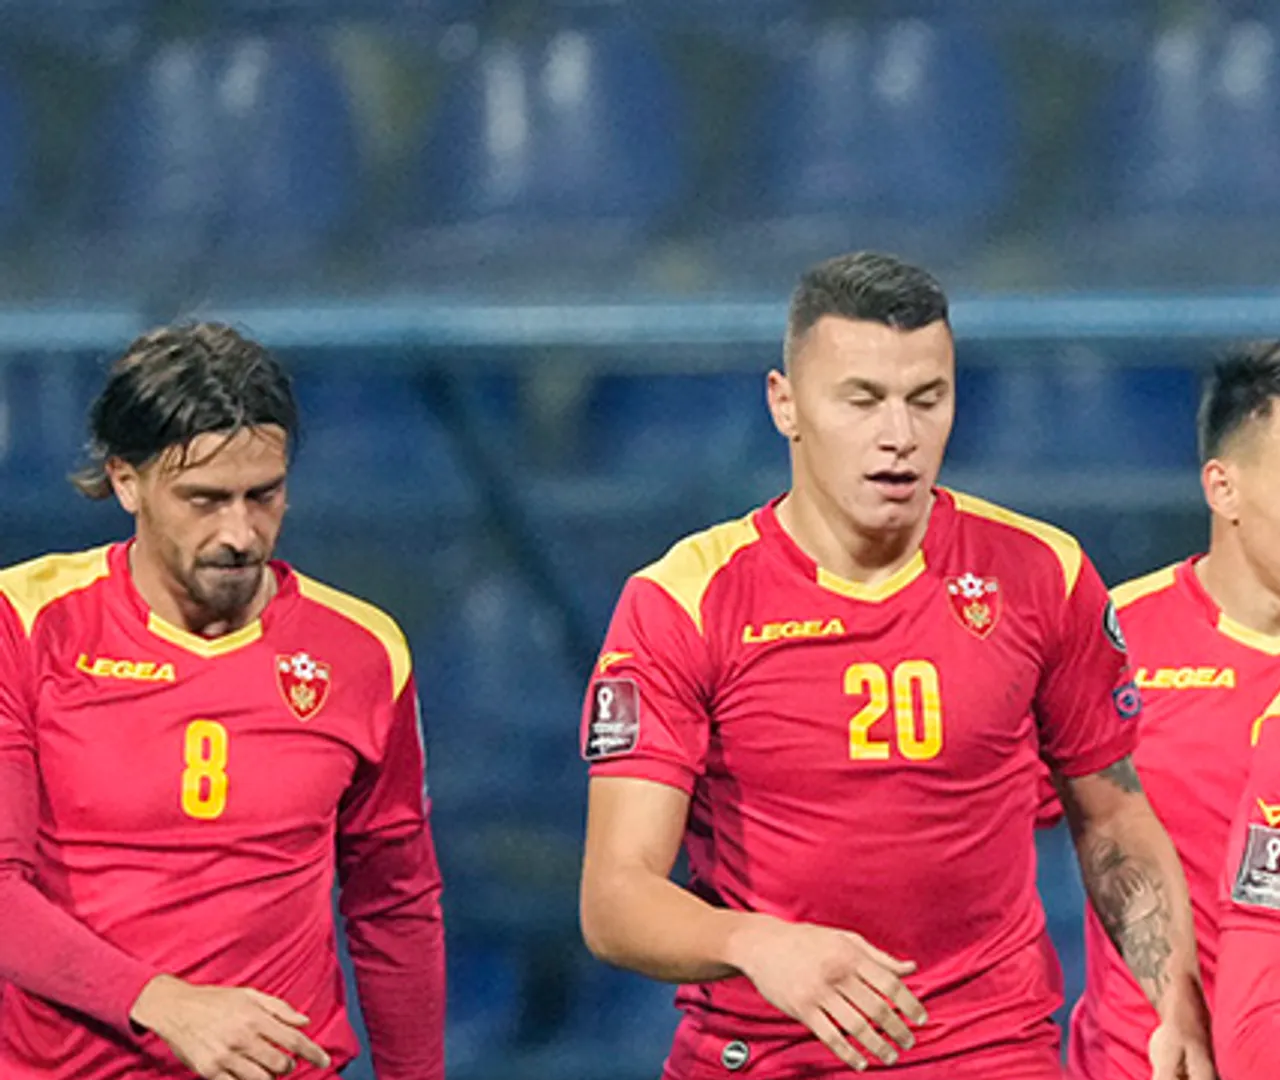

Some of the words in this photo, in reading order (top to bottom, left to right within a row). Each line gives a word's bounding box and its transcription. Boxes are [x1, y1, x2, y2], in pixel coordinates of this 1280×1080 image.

[743, 618, 845, 644] LEGEA
[75, 653, 176, 683] LEGEA
[1134, 666, 1236, 689] LEGEA
[843, 659, 943, 760] 20
[181, 719, 229, 819] 8
